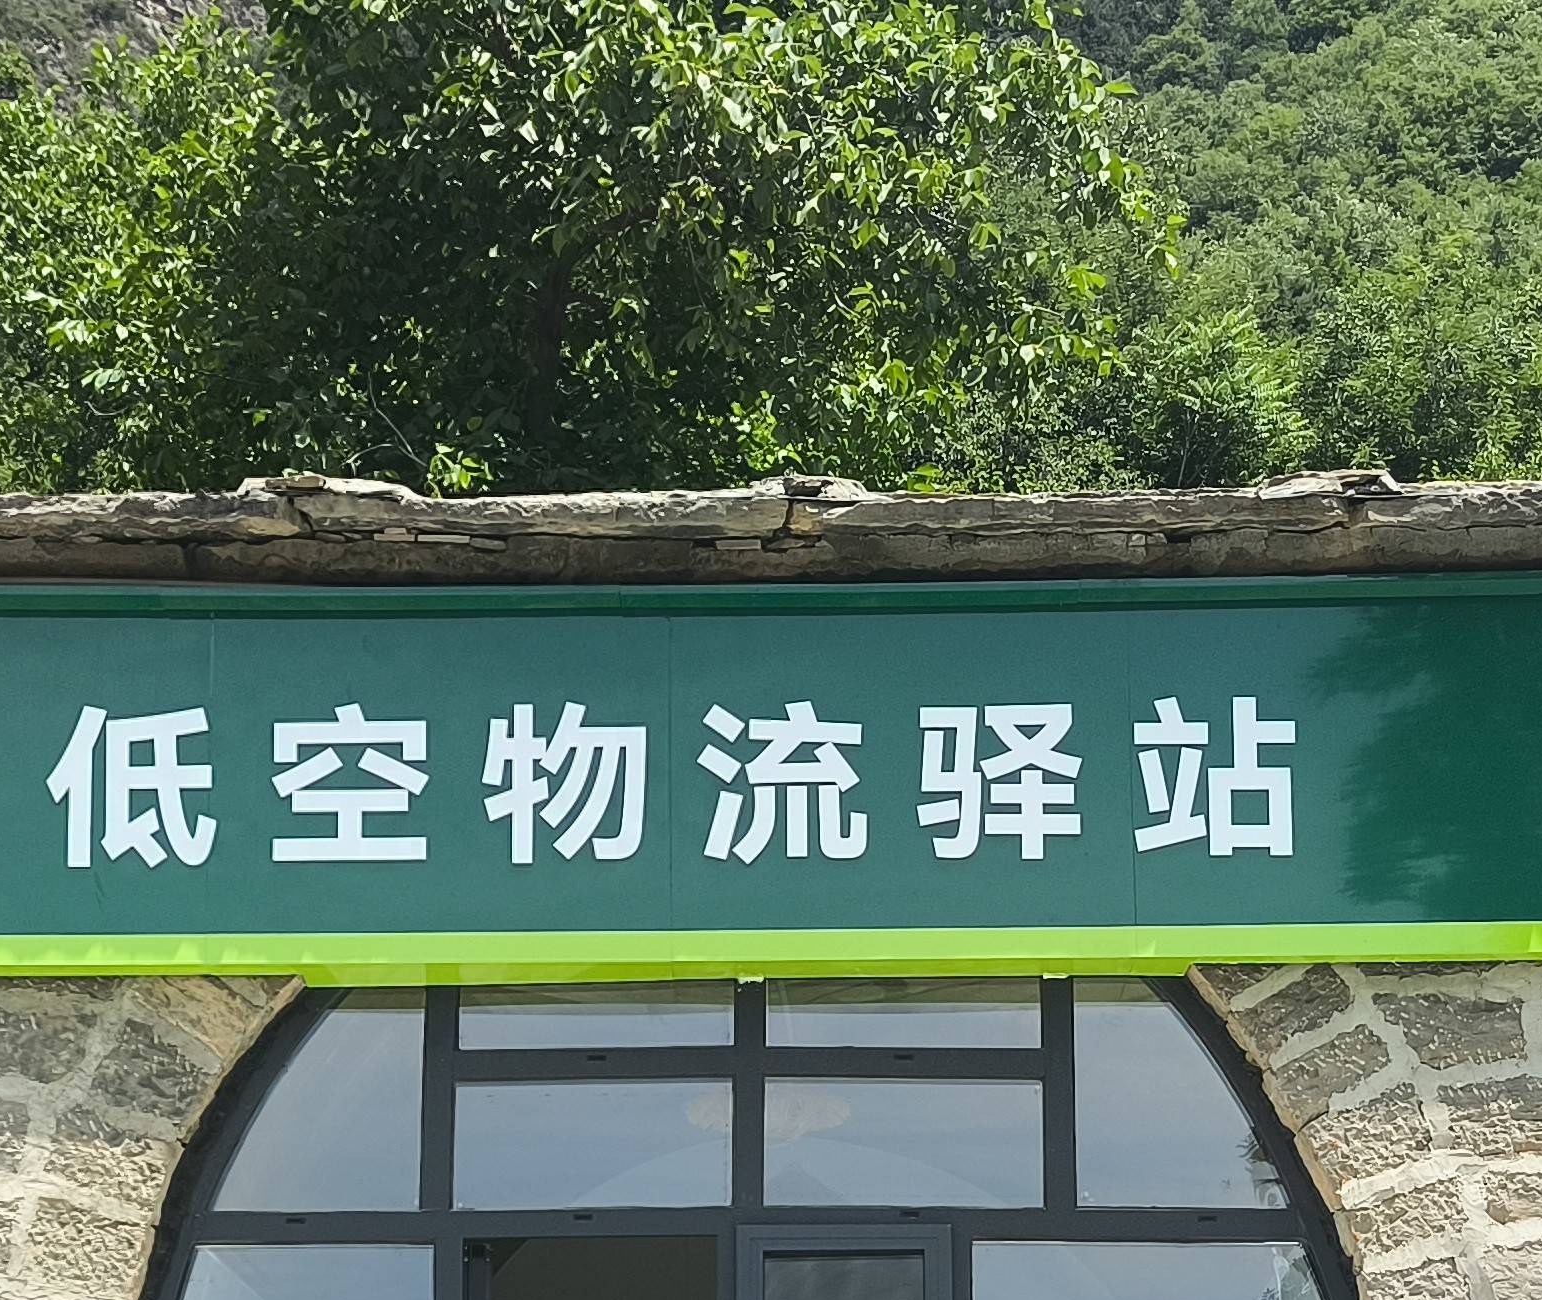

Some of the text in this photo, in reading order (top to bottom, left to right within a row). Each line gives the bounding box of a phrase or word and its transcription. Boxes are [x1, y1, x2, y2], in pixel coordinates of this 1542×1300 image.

[44, 694, 1298, 869] 低空物流驿站
